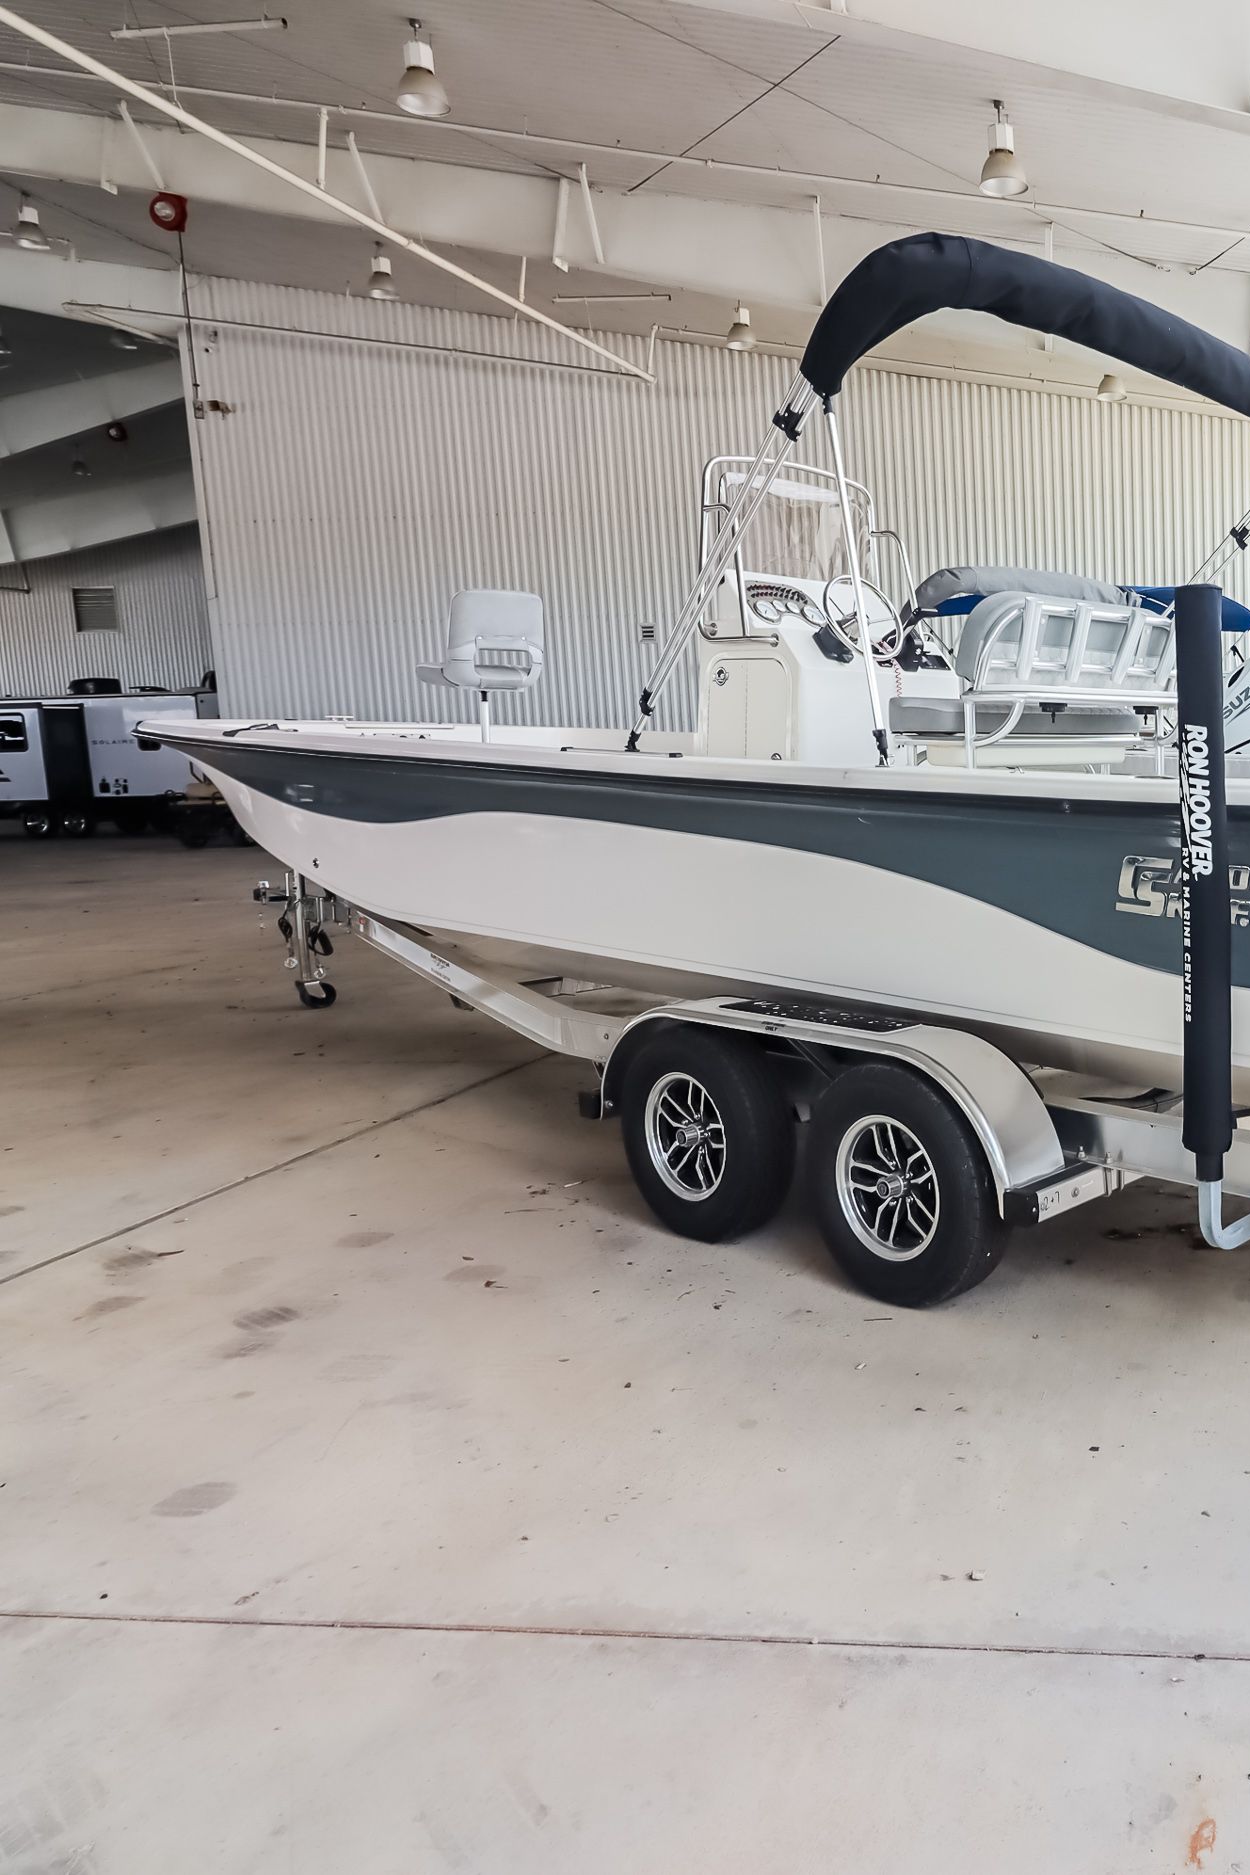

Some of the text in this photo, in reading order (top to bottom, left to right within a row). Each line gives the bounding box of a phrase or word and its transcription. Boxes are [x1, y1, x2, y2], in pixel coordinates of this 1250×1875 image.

[1185, 724, 1213, 877] RON HOOVER
[1181, 847, 1189, 868] RV
[1183, 886, 1191, 947] MARINE
[1184, 952, 1192, 1022] CENTERS
